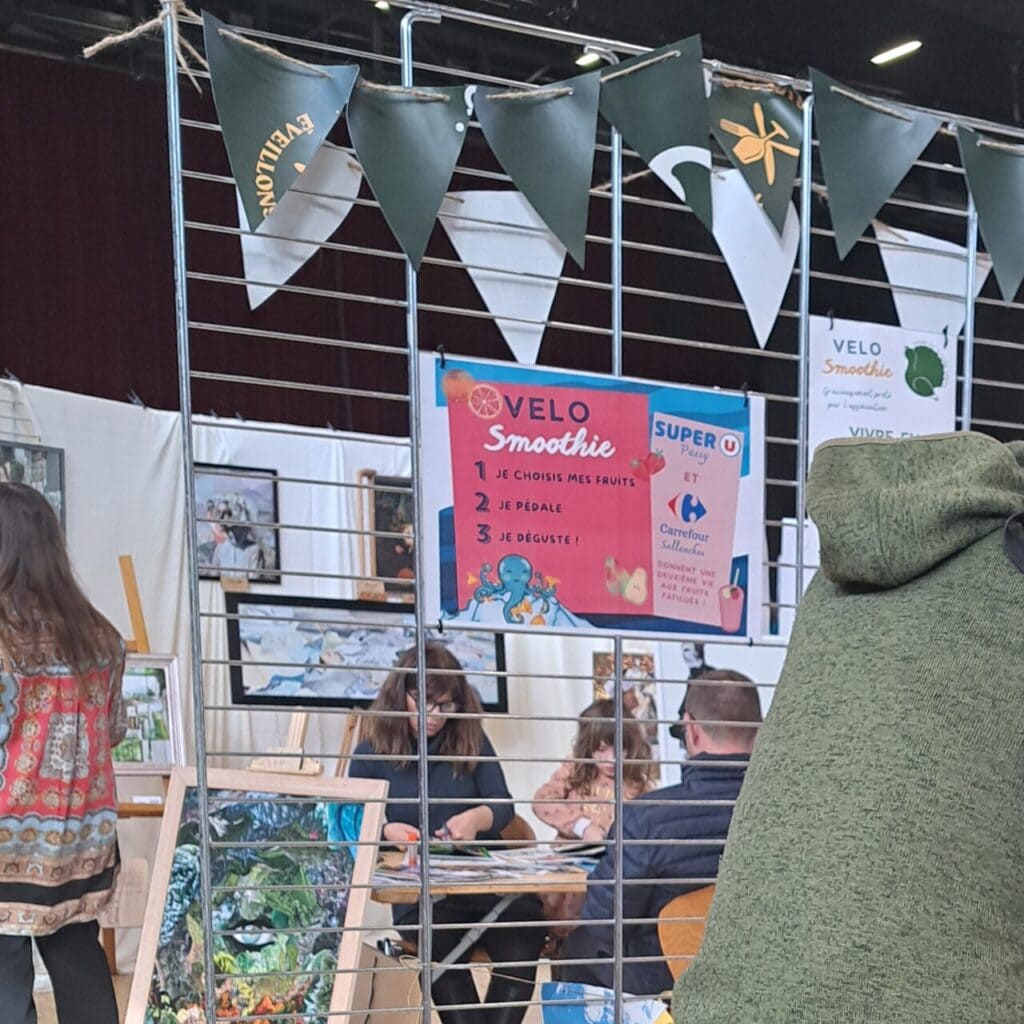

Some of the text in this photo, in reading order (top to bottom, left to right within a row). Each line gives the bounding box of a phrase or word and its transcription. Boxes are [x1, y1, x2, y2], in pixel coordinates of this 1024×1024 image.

[833, 339, 882, 356] VELO
[822, 359, 893, 378] Smoothie
[503, 395, 590, 424] VELO
[484, 424, 616, 458] Smoothie
[655, 420, 717, 450] SUPER
[681, 444, 710, 465] Passy
[474, 460, 636, 488] 1 JE CHOISIS MES FRUITS
[683, 471, 698, 483] ET
[474, 492, 563, 513] 2 JE PÉDALE
[476, 523, 492, 545] 3
[499, 532, 512, 542] JE
[517, 530, 571, 545] DÉGUSTE
[659, 523, 710, 542] Carrefour
